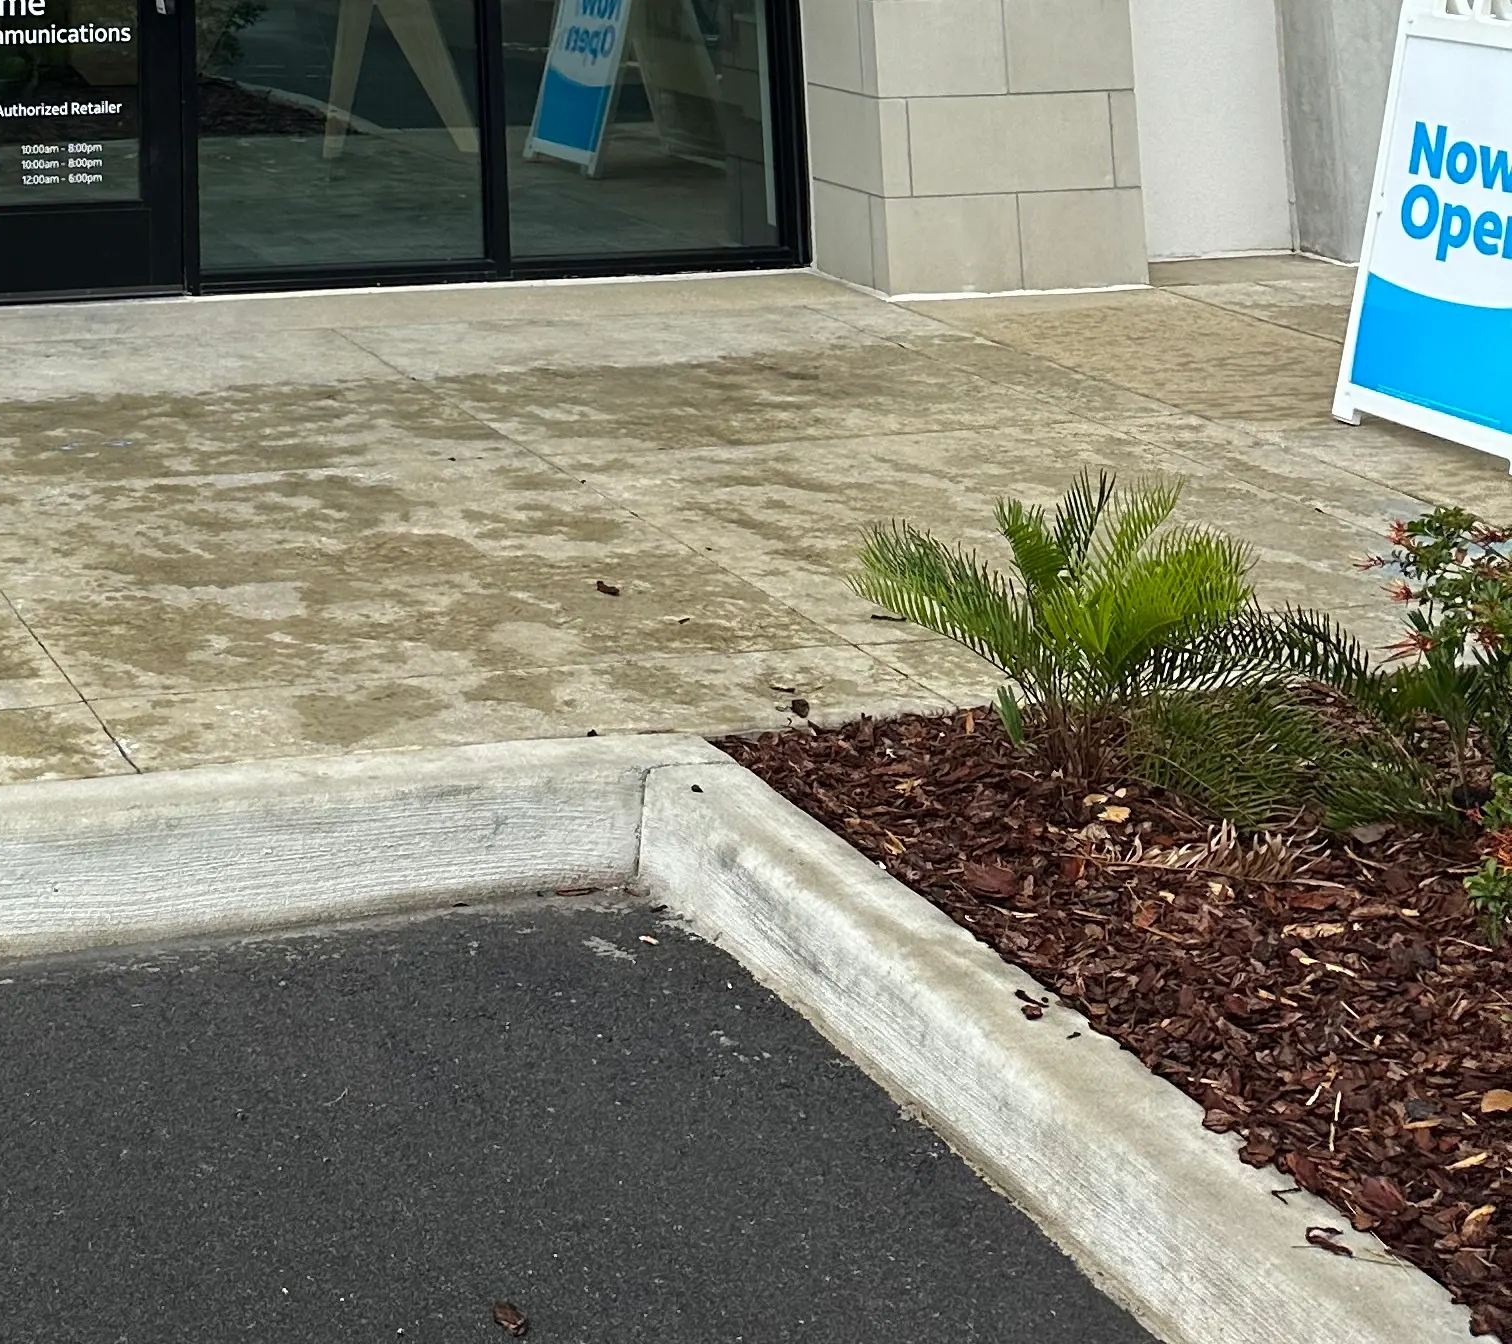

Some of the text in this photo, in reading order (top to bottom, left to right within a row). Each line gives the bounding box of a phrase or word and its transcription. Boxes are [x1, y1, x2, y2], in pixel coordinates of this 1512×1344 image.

[71, 100, 123, 115] Retailer
[21, 144, 60, 155] 10:00am
[68, 143, 103, 155] 8:00pm
[21, 159, 60, 170] 10:00am
[68, 157, 103, 170] 8:00pm
[21, 174, 60, 185] 12:00am
[68, 173, 103, 185] 6:00pm
